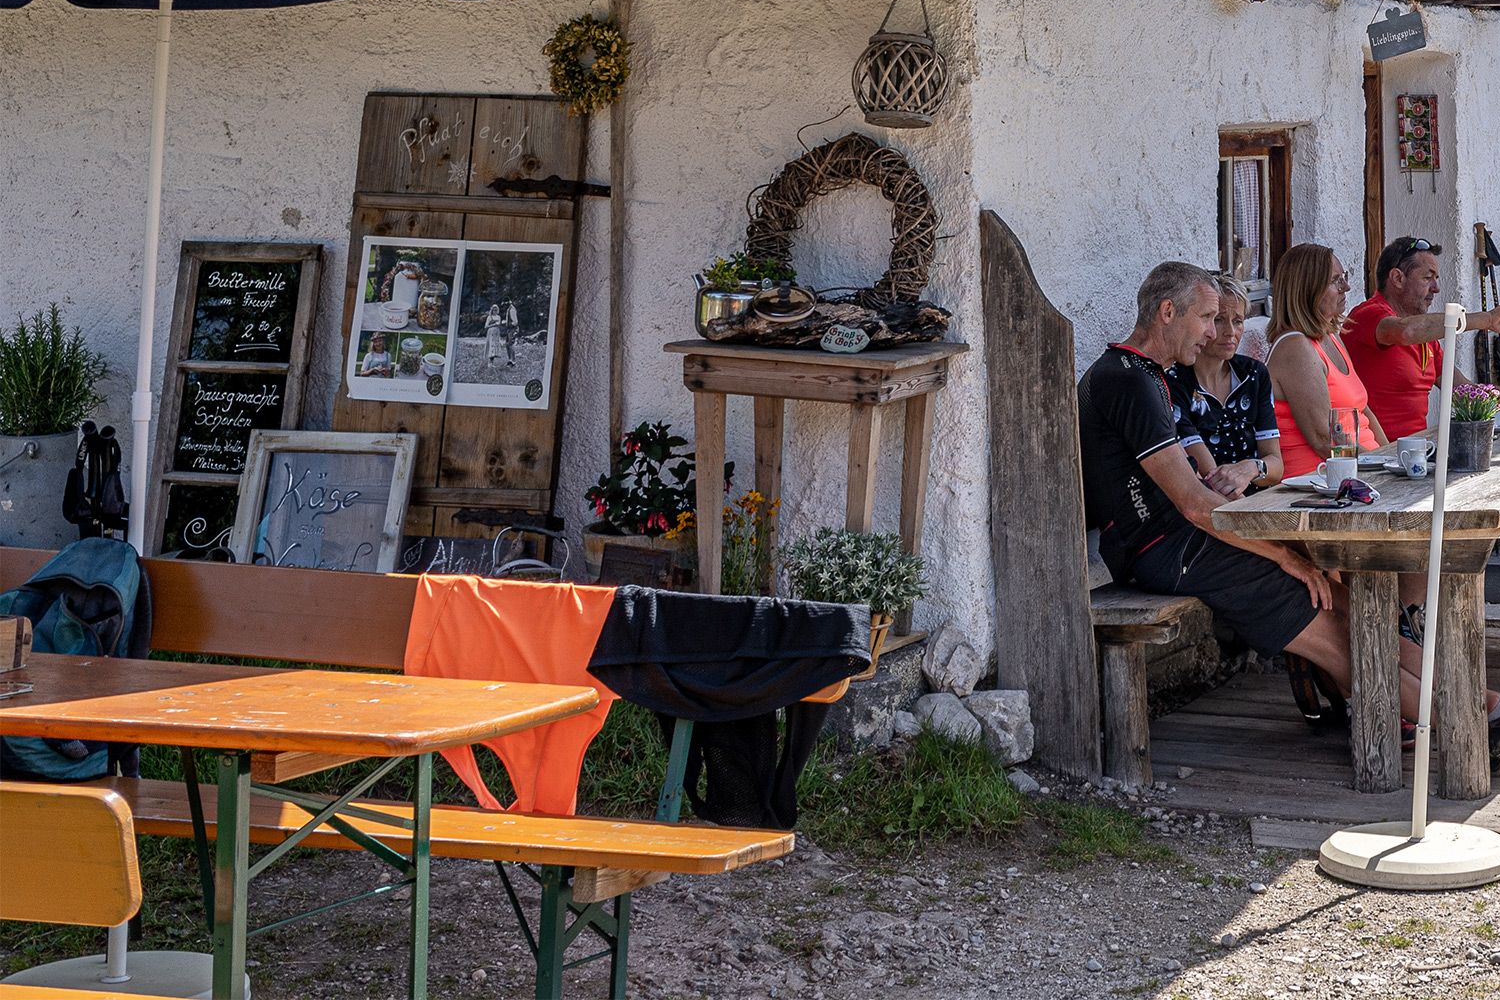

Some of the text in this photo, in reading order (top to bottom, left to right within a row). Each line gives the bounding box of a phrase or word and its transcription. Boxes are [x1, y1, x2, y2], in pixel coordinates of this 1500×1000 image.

[1371, 26, 1422, 47] Lieblingspla
[242, 291, 277, 312] Frucht
[266, 326, 282, 343] €
[194, 381, 280, 413] hausgmachte
[194, 406, 252, 432] Schorlen
[272, 462, 362, 521] Käse
